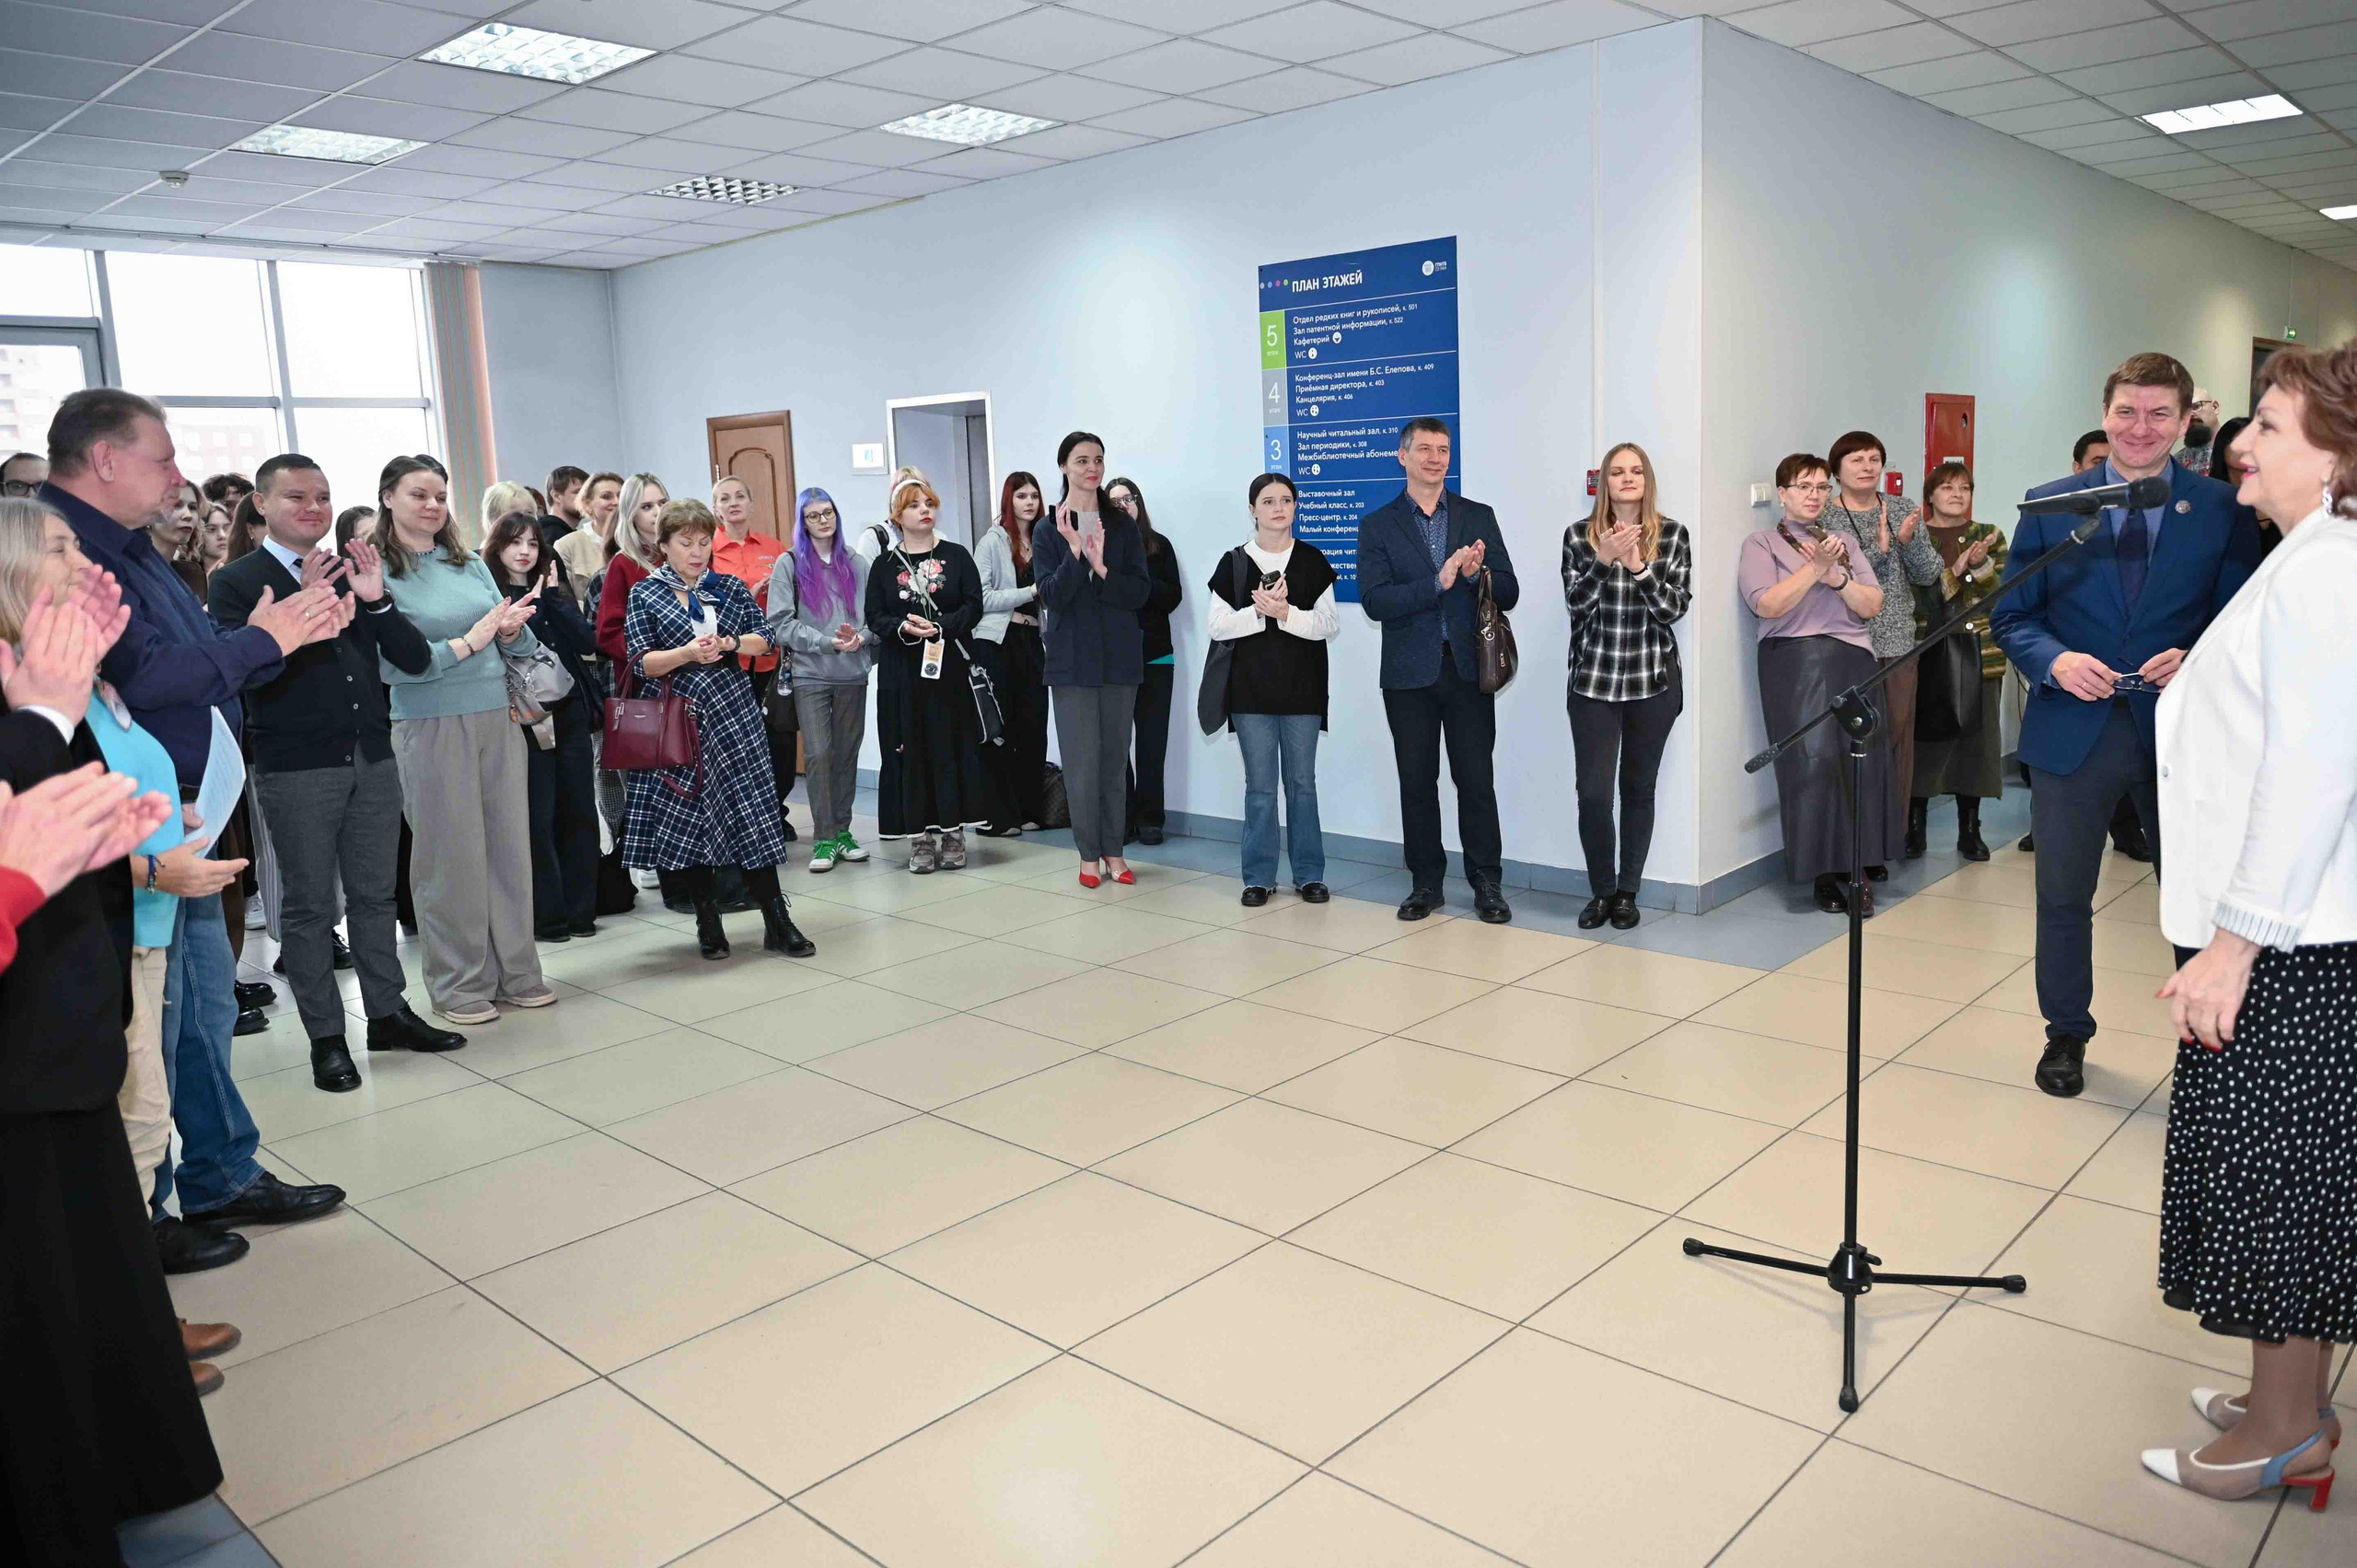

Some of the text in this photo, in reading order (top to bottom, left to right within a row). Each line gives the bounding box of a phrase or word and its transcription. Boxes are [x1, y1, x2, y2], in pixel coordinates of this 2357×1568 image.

[1292, 269, 1363, 293] ПЛАН ЭТАЖЕЙ
[1293, 315, 1314, 324] Отдел
[1315, 313, 1339, 323] редких
[1363, 304, 1401, 318] рукописей,
[1293, 327, 1306, 335] Зал
[1306, 322, 1341, 333] патентной
[1341, 319, 1387, 331] информации,
[1266, 324, 1278, 347] 5
[1294, 334, 1329, 346] Кафетерий
[1295, 350, 1307, 359] WC
[1295, 371, 1345, 383] Конференц-зал
[1346, 369, 1369, 377] имени
[1369, 366, 1384, 376] Б.С.
[1385, 365, 1417, 375] Елепова,
[1268, 381, 1281, 404] 4
[1295, 384, 1329, 394] Приёмная
[1329, 380, 1368, 391] директора,
[1295, 394, 1337, 404] Канцелярия,
[1296, 408, 1308, 416] WC
[1296, 429, 1327, 440] Научный
[1328, 427, 1366, 437] читальный
[1367, 427, 1381, 436] зал,
[1271, 439, 1282, 460] 3
[1297, 442, 1310, 450] Зал
[1311, 442, 1352, 452] периодики,
[1297, 448, 1399, 461] Межбиблиотечный абонеме
[1298, 467, 1311, 475] WC
[1298, 489, 1342, 498] Выставочный
[1298, 501, 1327, 510] Учебный
[1299, 513, 1342, 523] Пресс-центр,
[1299, 525, 1322, 533] Малый
